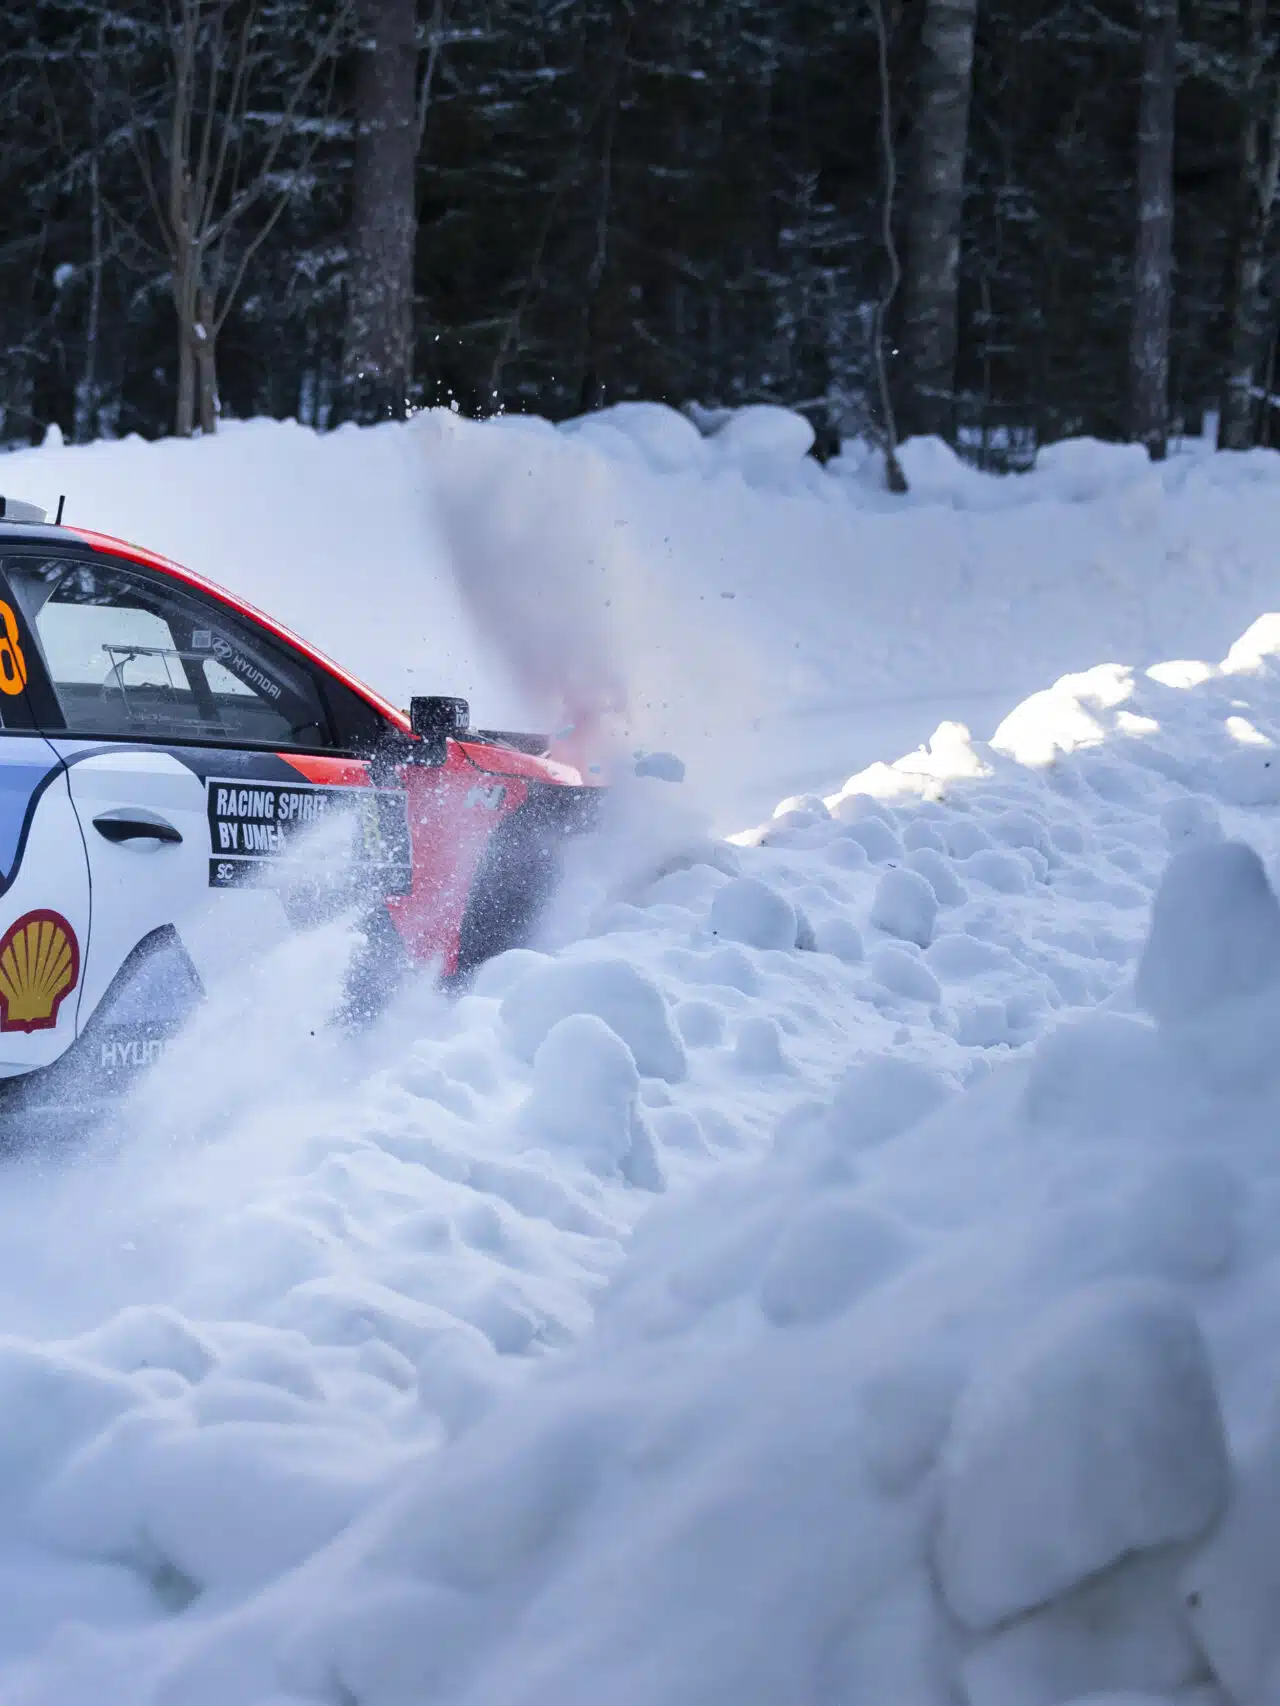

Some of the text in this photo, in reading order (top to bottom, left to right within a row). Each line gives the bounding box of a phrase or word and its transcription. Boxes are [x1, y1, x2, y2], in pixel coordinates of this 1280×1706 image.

[232, 655, 282, 700] HYUNDAI
[216, 788, 328, 822] RACING SPIRIT
[218, 822, 238, 849] BY
